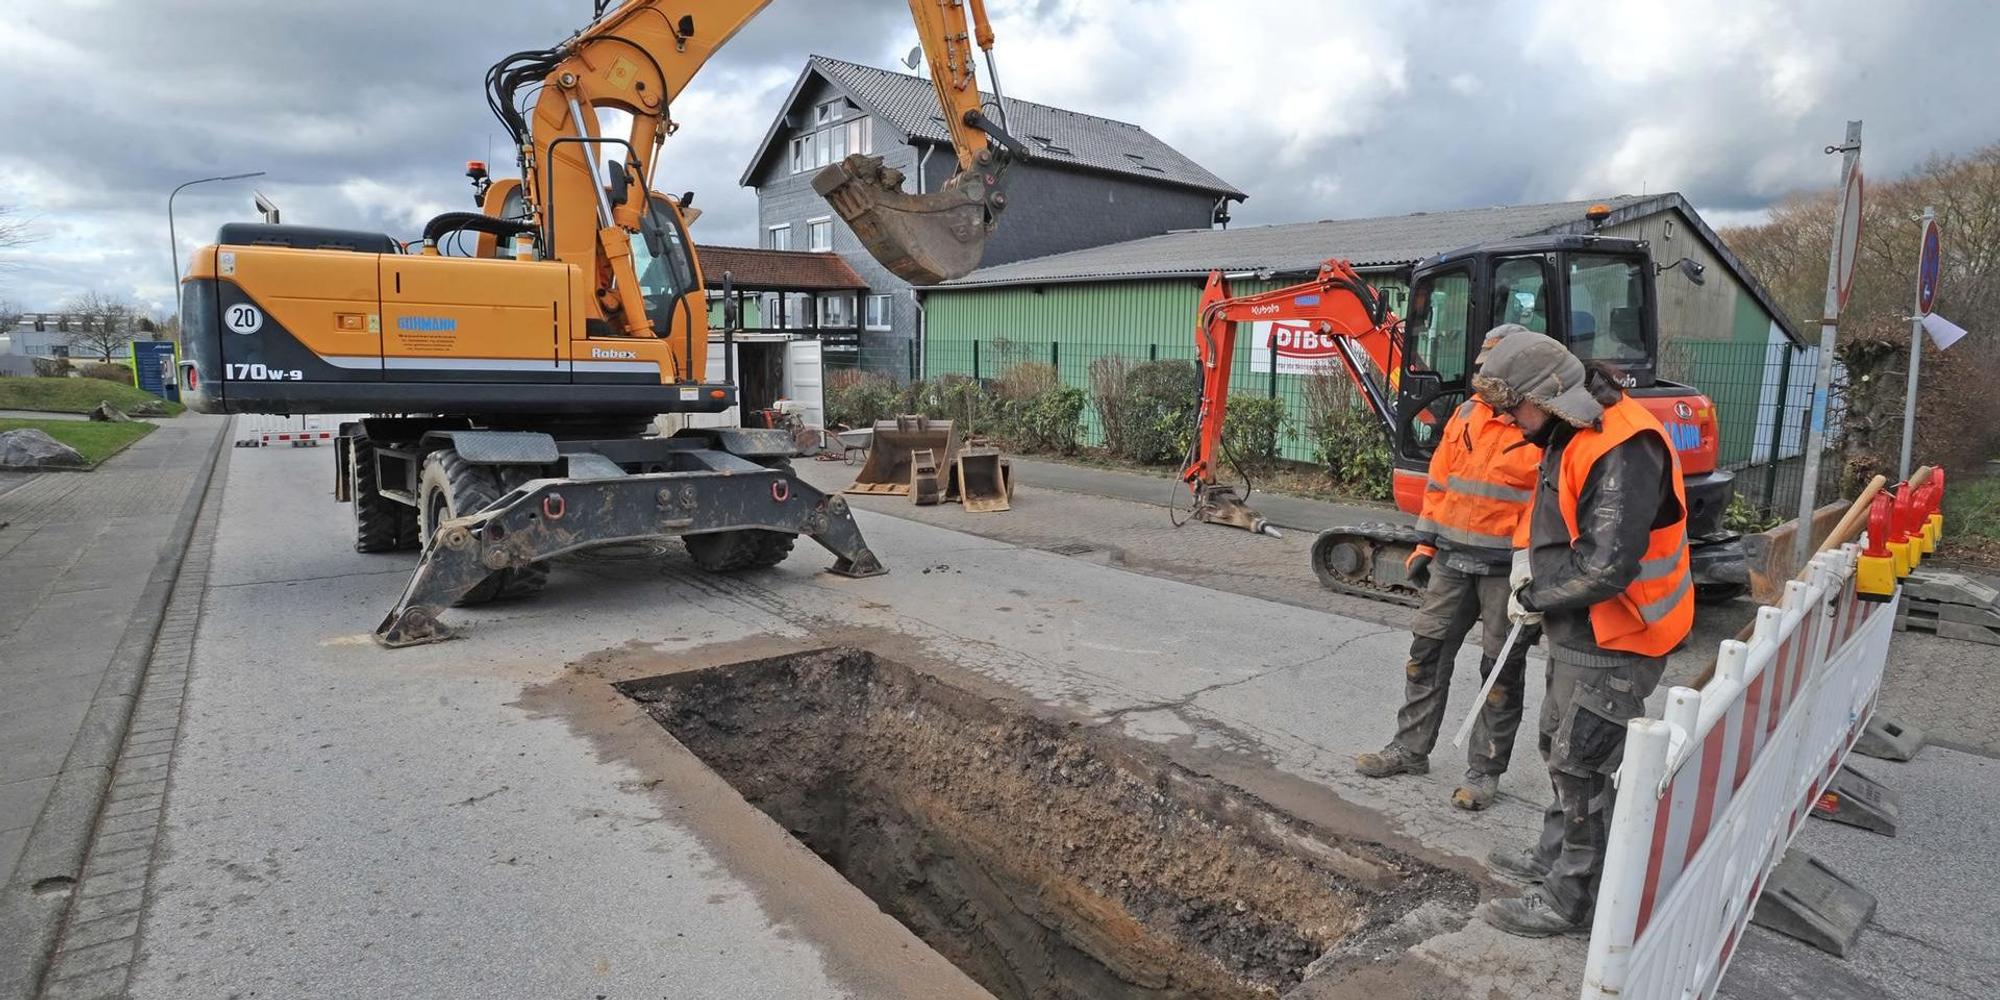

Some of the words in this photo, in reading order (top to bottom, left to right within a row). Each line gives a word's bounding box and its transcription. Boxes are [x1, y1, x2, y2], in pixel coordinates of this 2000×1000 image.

[1251, 303, 1280, 315] Kubota
[233, 308, 255, 328] 20
[591, 347, 637, 359] Robex
